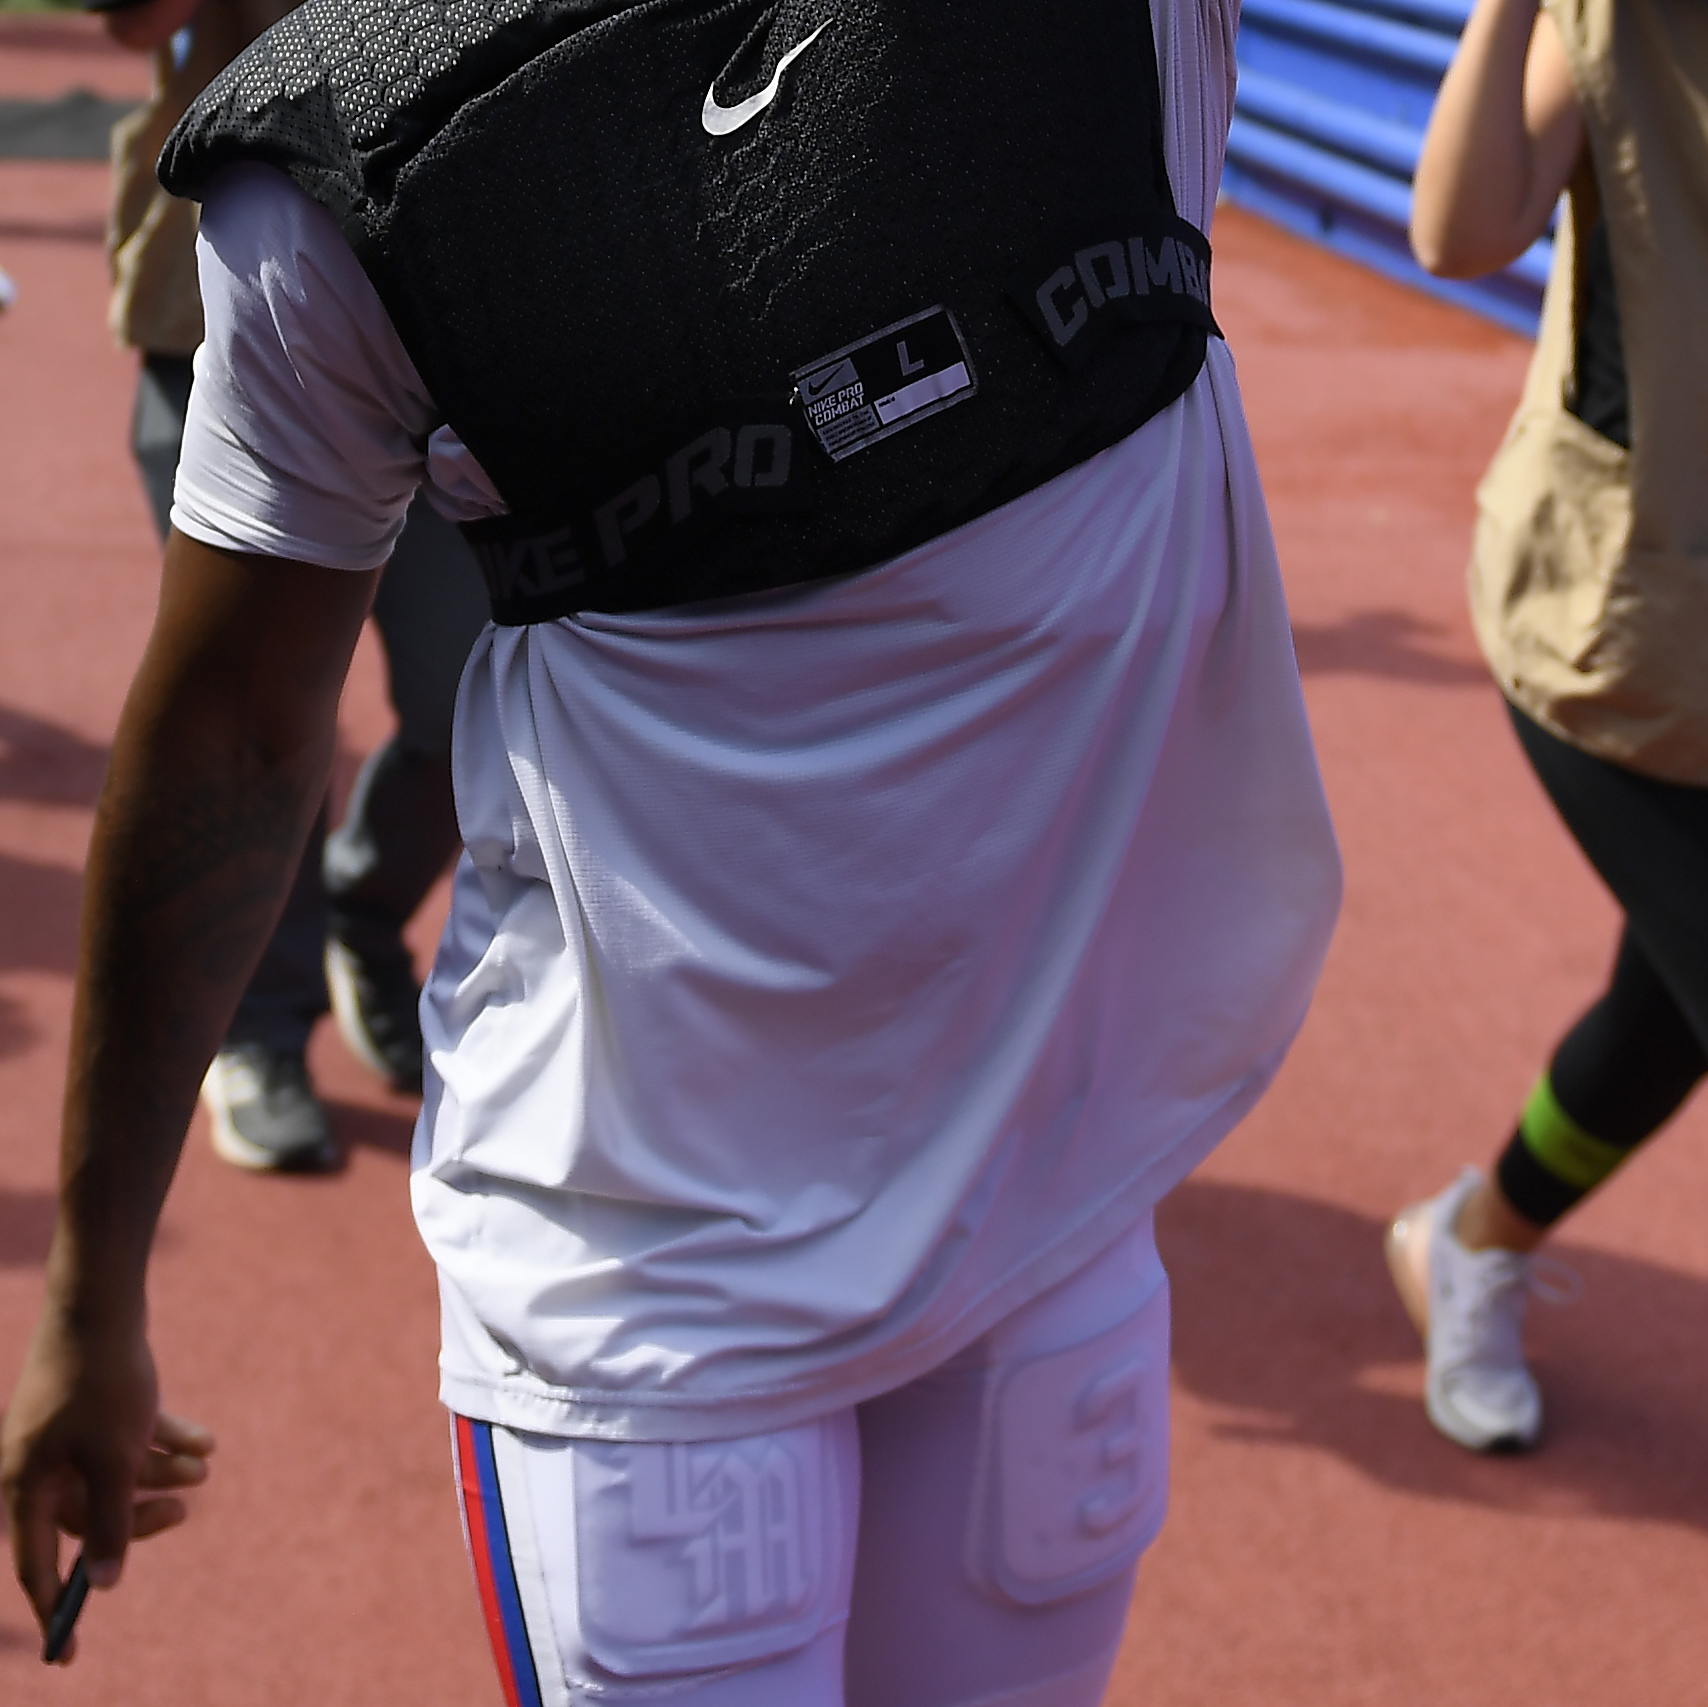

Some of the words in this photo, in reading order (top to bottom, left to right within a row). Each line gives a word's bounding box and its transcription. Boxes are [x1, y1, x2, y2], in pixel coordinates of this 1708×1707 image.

[895, 340, 925, 377] L
[807, 395, 838, 419] NIKE
[837, 381, 864, 402] PRO
[814, 393, 866, 427] COMBAT
[473, 527, 586, 600] IKE
[593, 424, 792, 568] PRO
